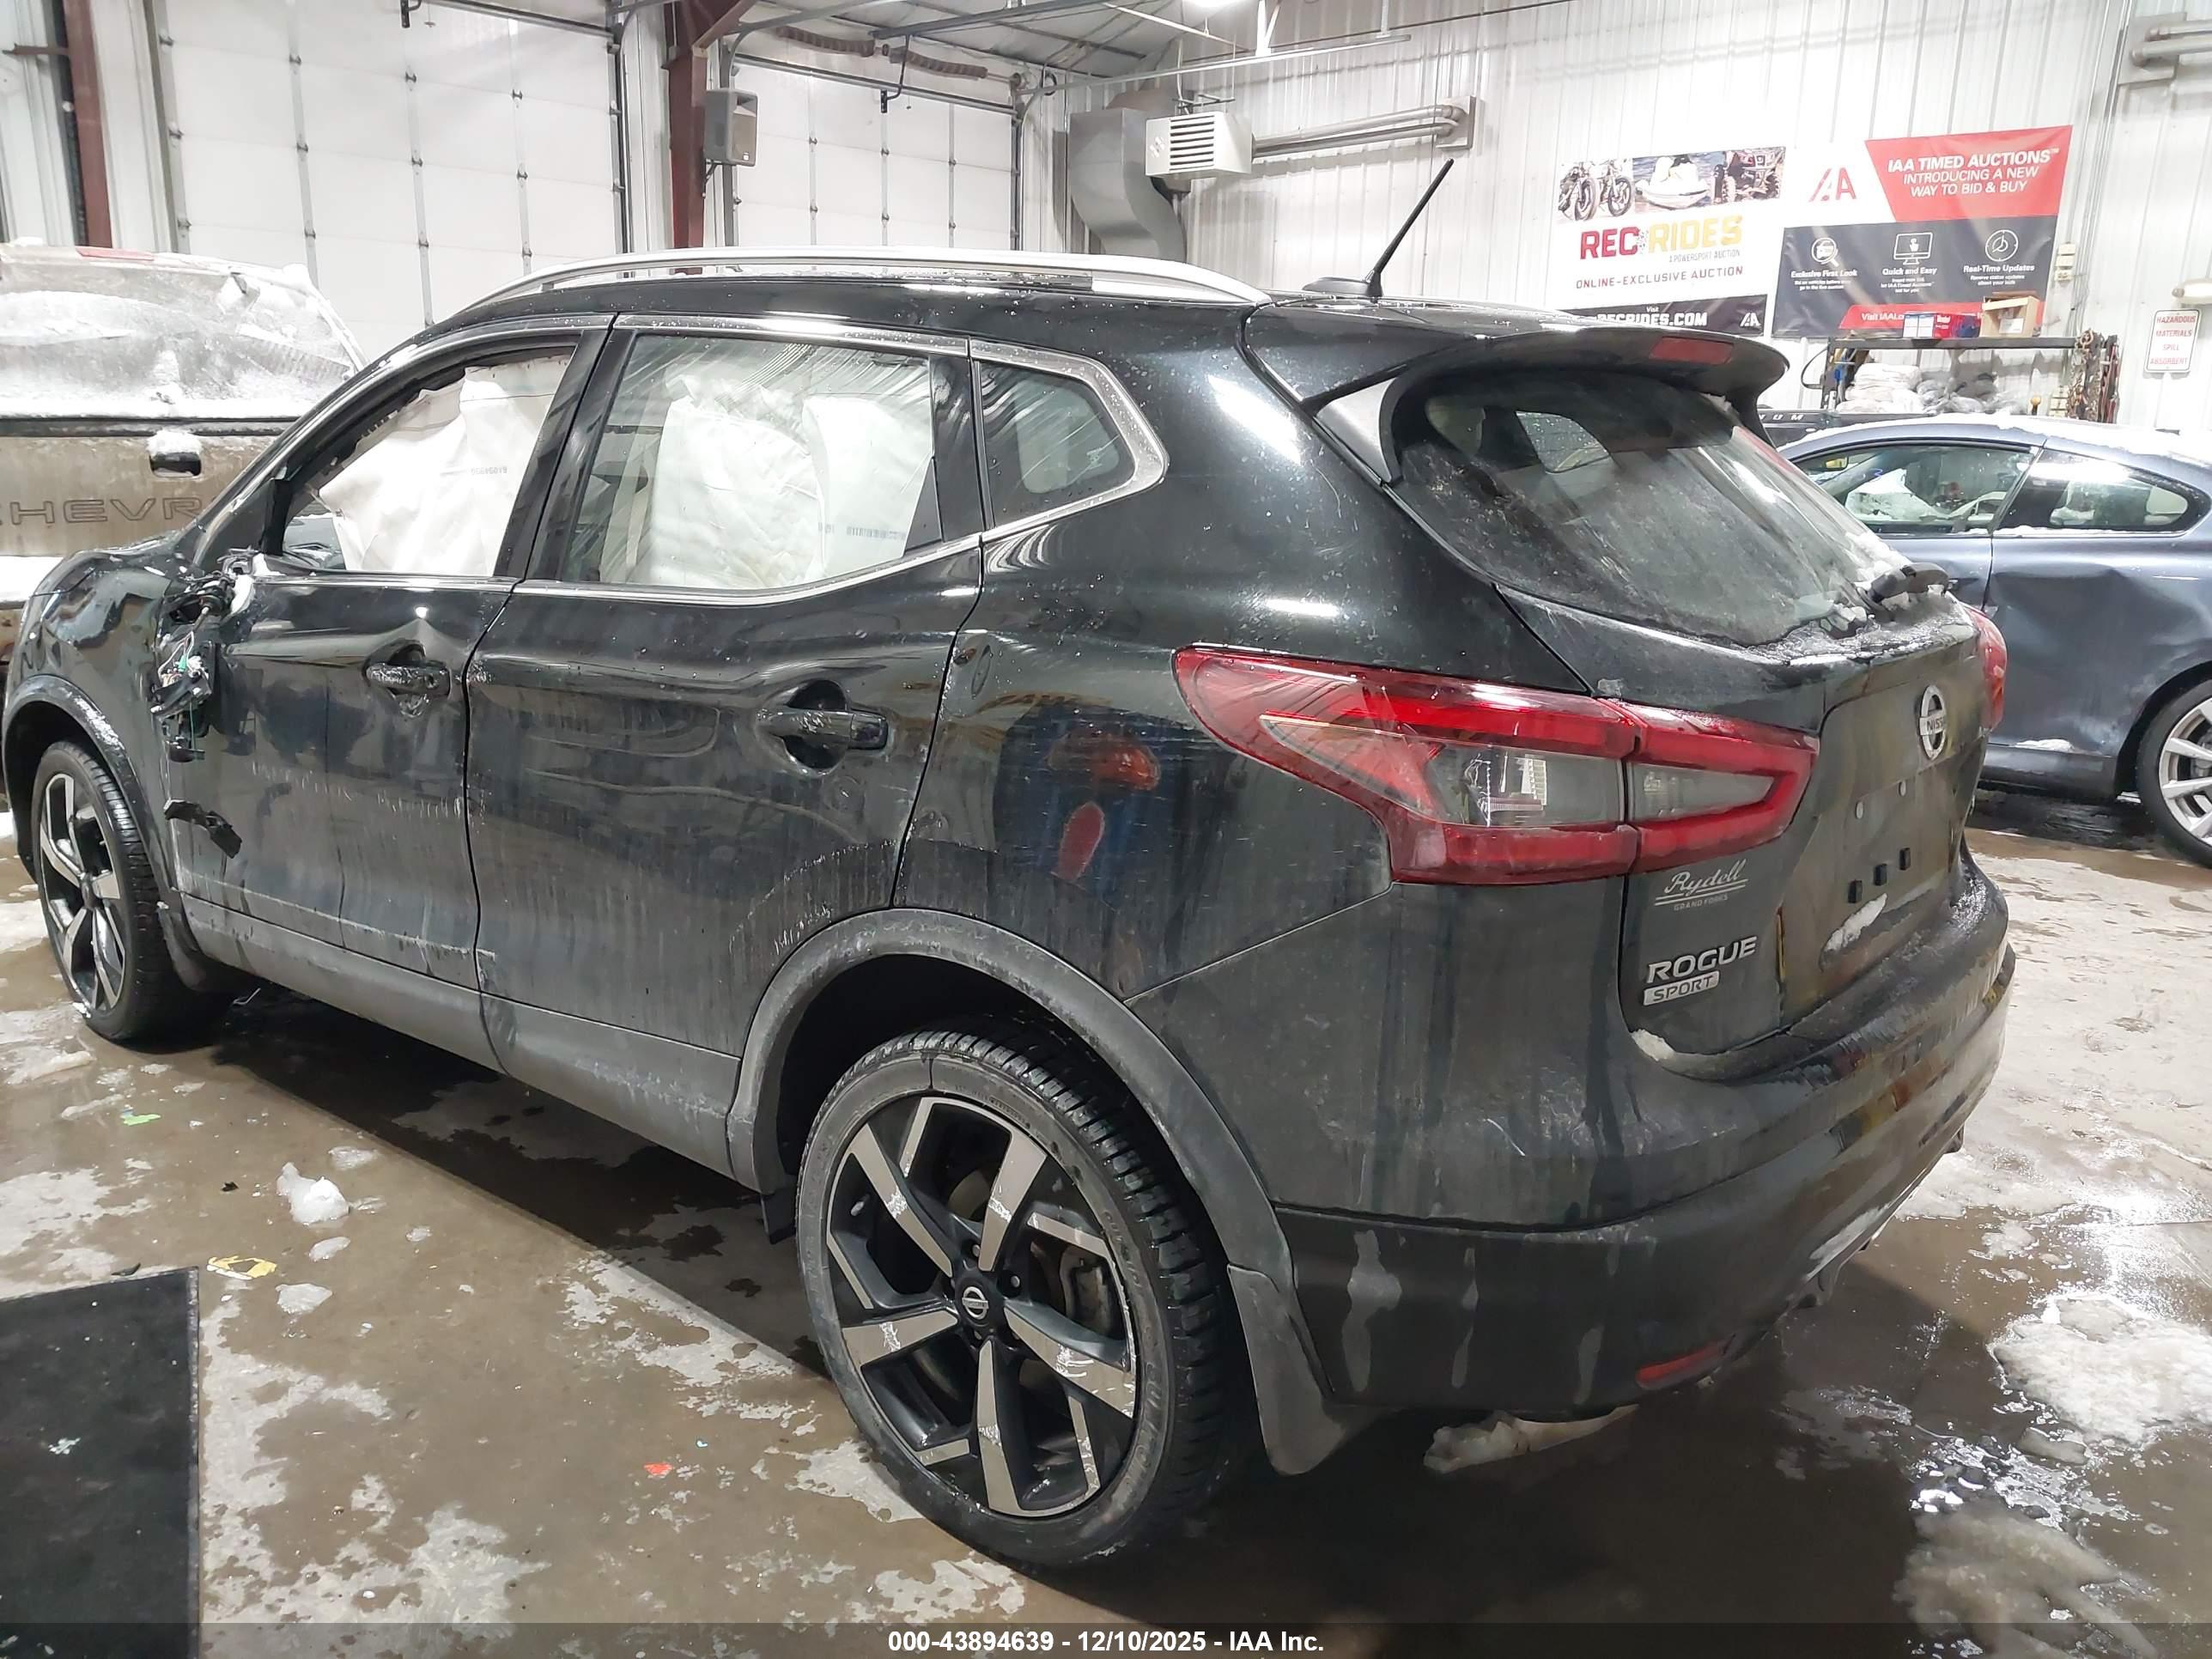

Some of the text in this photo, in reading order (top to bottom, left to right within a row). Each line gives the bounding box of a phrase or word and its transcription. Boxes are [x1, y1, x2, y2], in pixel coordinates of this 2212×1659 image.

[1887, 158, 1914, 173] IAA
[1918, 155, 1965, 171] TIMED
[1904, 166, 2039, 185] INTRODUCING A NEW
[1911, 180, 2027, 197] WAY TO BID & BUY
[1580, 215, 1743, 260] REC RIDES
[1576, 265, 1744, 289] ONLINE-EXCLUSIVE AUCTION
[1881, 267, 1904, 276] Quick
[1920, 266, 1938, 276] Easy
[1963, 264, 2001, 273] Real-Time
[1861, 313, 1879, 321] Visit
[2156, 315, 2197, 324] HAZARDOUS
[2155, 329, 2192, 337] MATERIALS
[1664, 858, 1747, 896] Rydell
[1674, 899, 1703, 911] GRAND
[1646, 935, 1758, 984] ROGUE
[1653, 975, 1714, 1002] SPORT
